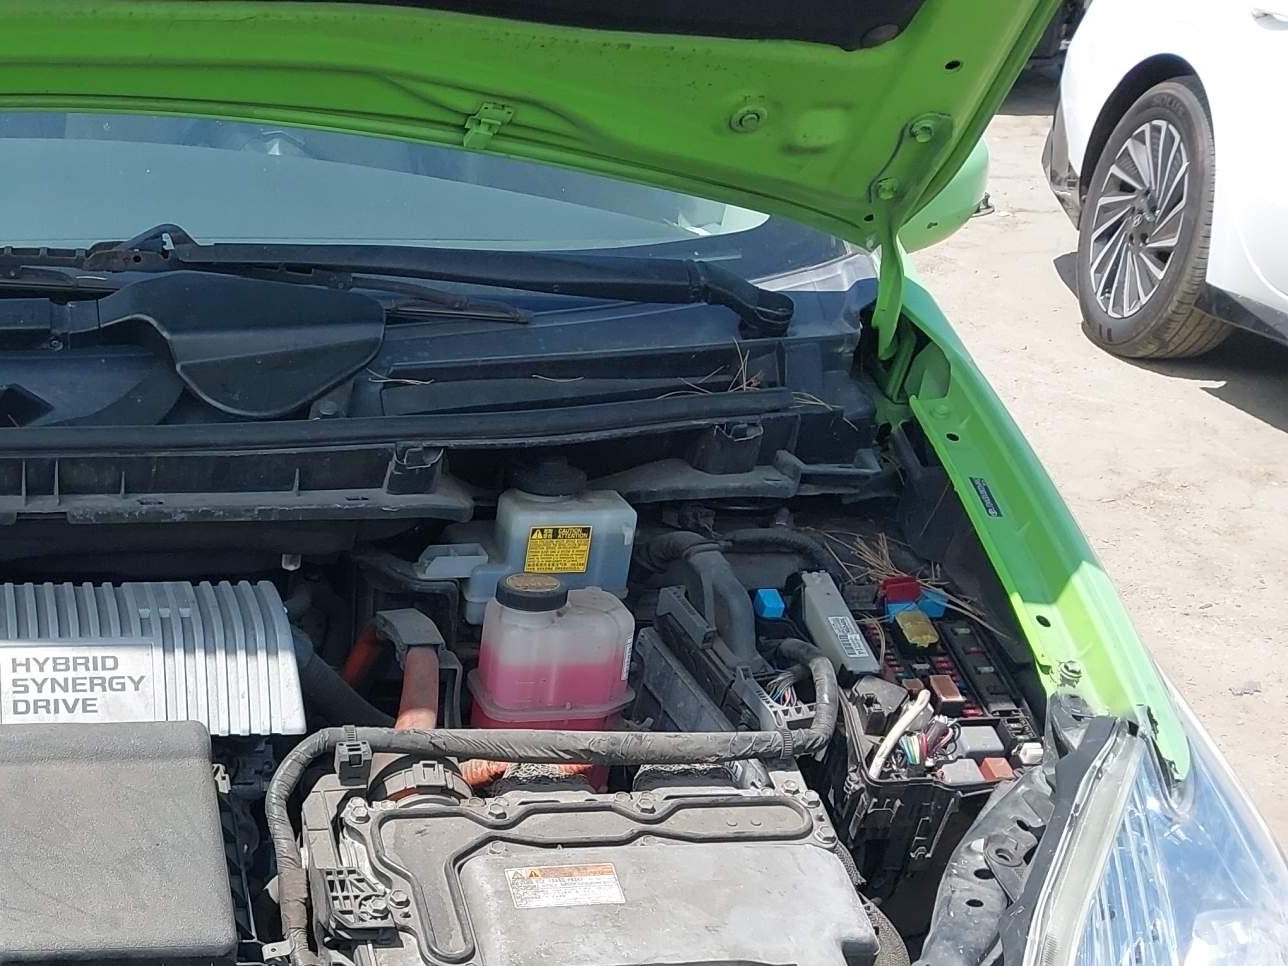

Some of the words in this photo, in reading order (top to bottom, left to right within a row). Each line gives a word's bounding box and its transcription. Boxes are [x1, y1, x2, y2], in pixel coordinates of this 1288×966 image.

[11, 655, 119, 673] HYBRID
[11, 675, 146, 694] SYNERGY
[12, 698, 98, 715] DRIVE
